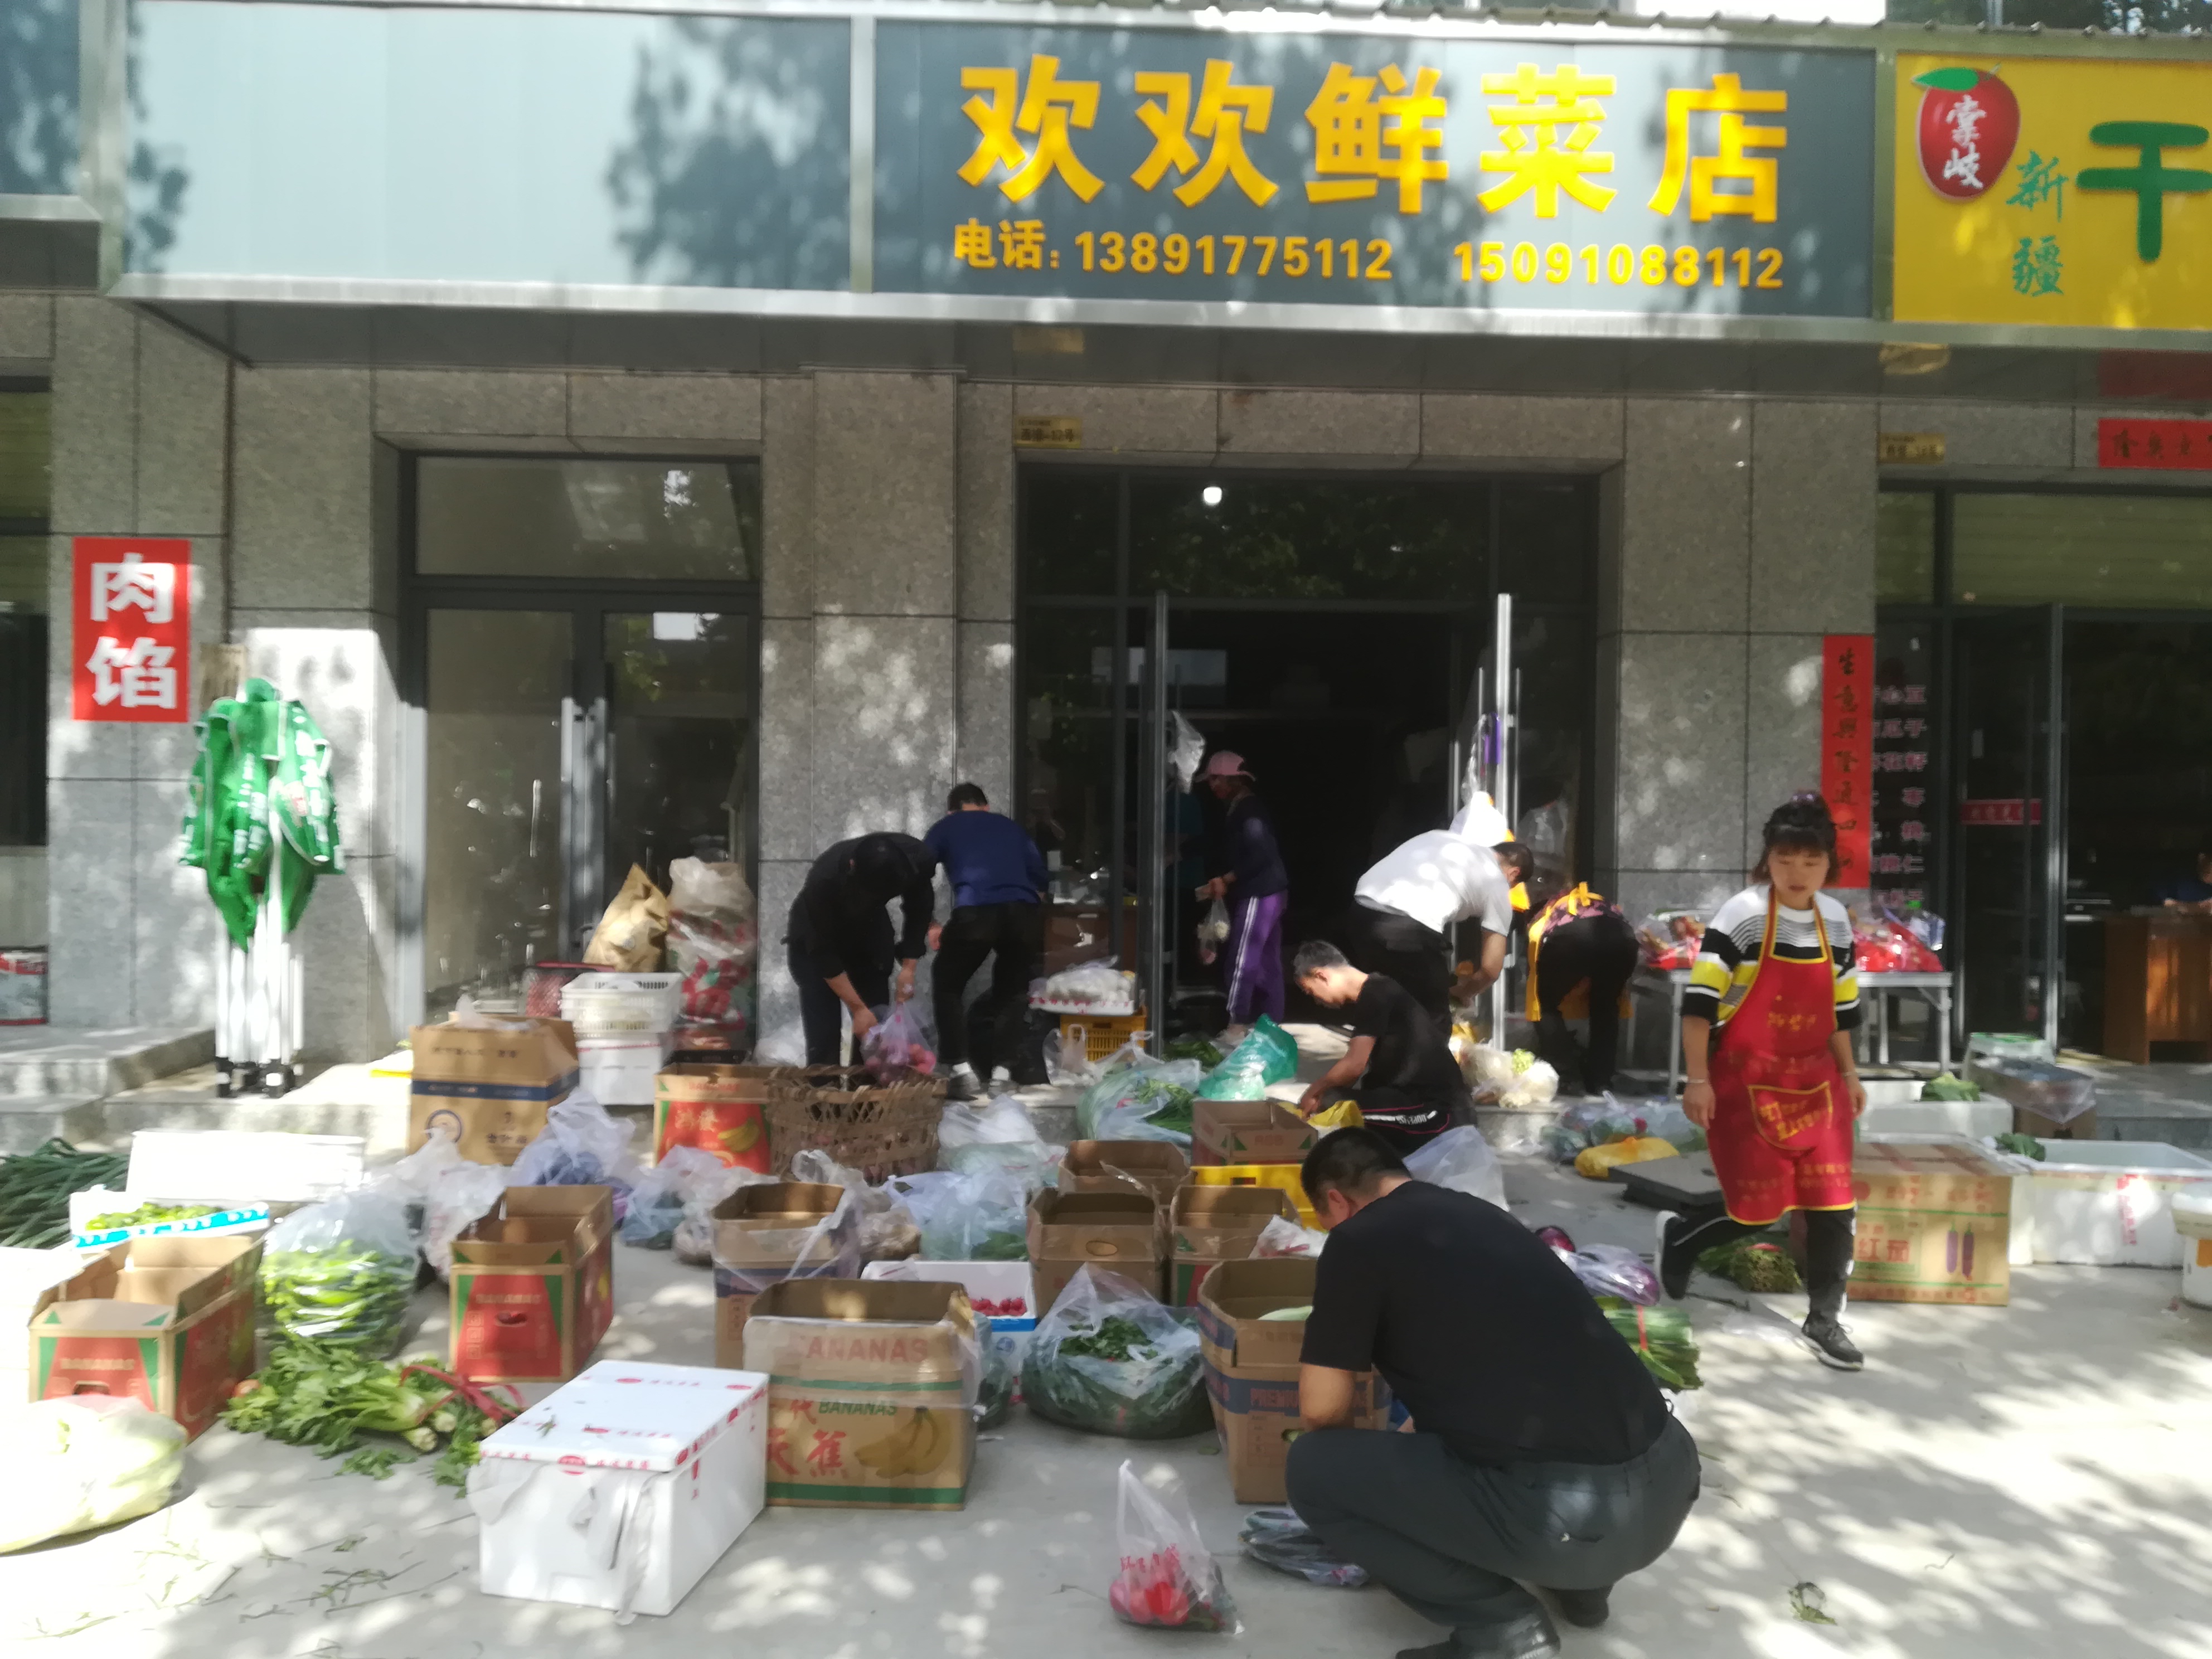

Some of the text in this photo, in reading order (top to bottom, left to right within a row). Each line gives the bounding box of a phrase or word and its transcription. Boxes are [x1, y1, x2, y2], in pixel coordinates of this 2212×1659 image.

[956, 54, 1788, 223] 欢欢鲜菜店
[1453, 241, 1784, 289] 15091088112
[87, 552, 177, 709] 肉馅
